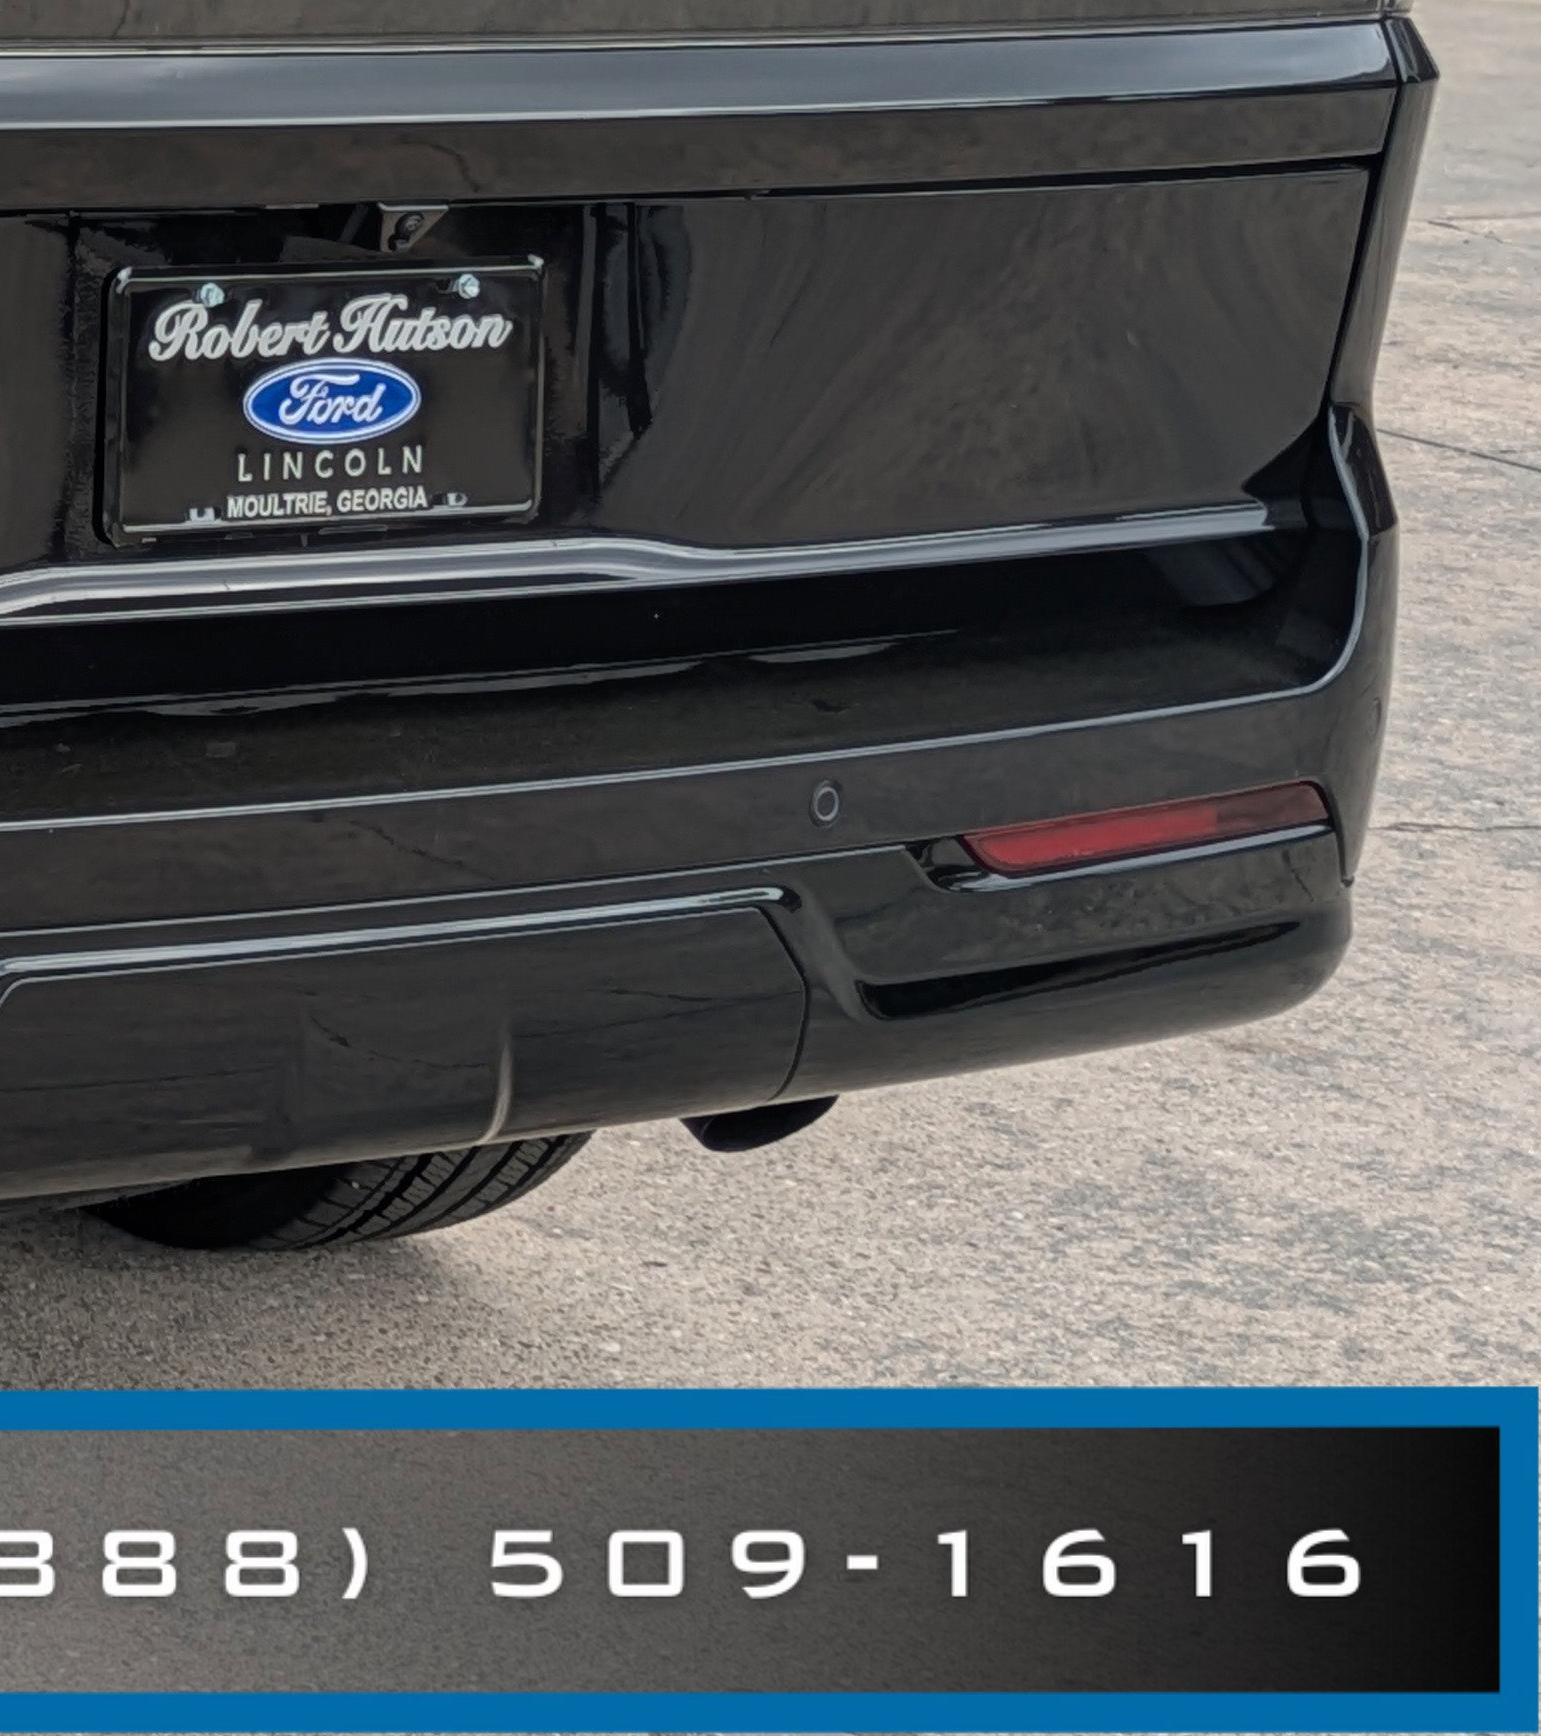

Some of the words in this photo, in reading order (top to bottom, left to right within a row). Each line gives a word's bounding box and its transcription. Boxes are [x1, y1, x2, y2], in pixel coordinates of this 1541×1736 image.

[148, 298, 331, 361] Robert
[332, 293, 514, 354] Hutson
[278, 373, 388, 426] Ford
[237, 444, 423, 483] LINCOLN
[227, 490, 333, 520] MOULTRIE,
[336, 485, 429, 514] GEORGIA
